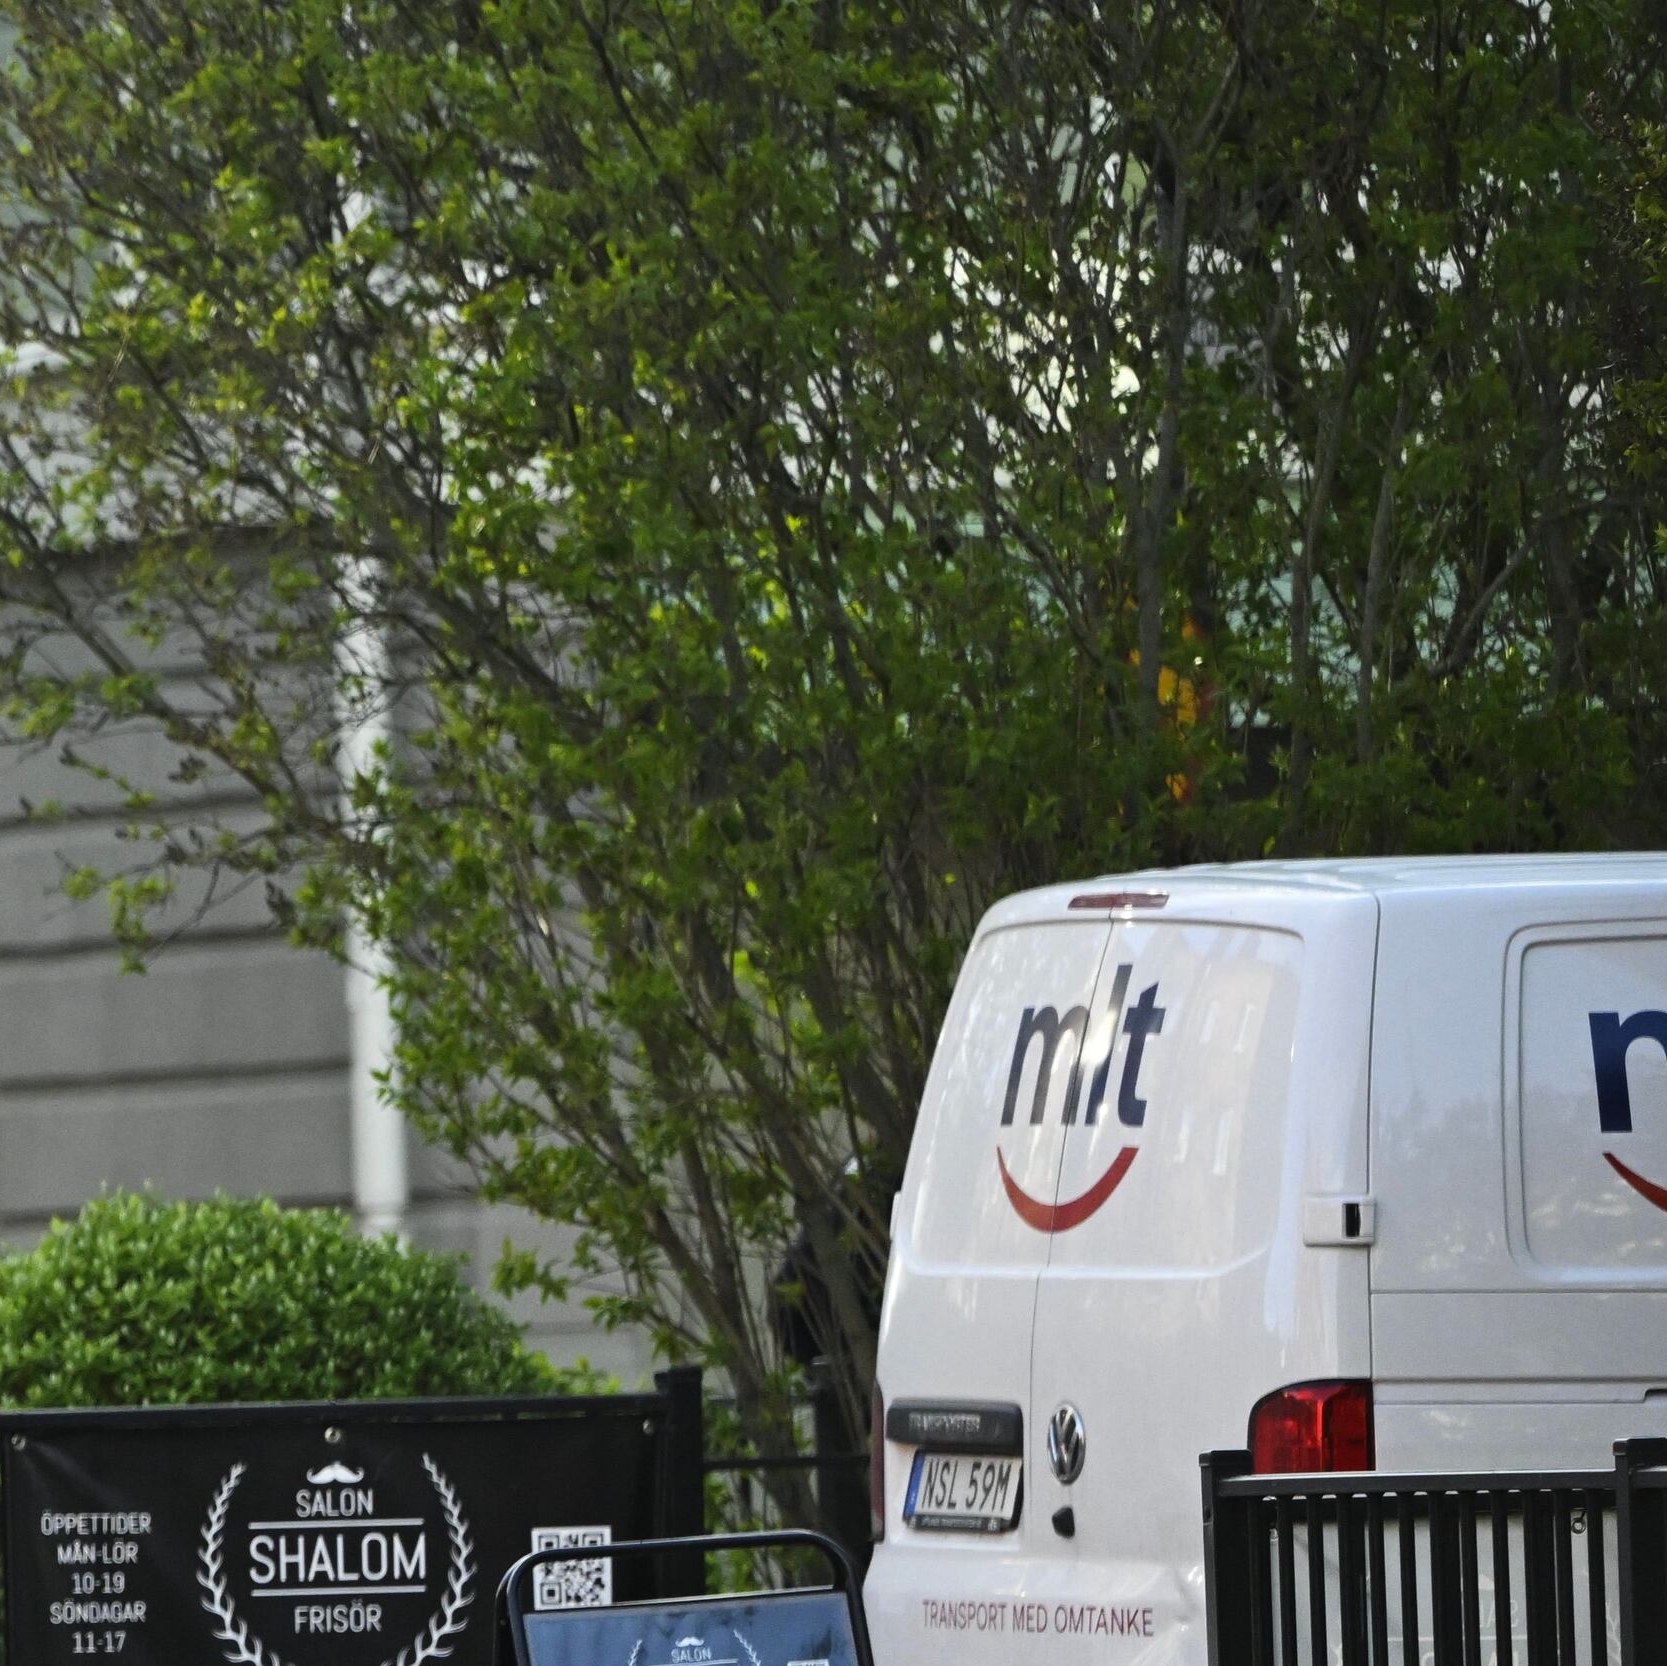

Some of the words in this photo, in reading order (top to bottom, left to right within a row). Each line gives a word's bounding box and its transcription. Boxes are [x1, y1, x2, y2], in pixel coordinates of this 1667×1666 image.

[1000, 963, 1166, 1128] mlt
[921, 1458, 959, 1510] NSL
[965, 1461, 1013, 1512] 59M
[295, 1488, 374, 1518] SALON
[40, 1509, 152, 1536] ÖPPETTIDER
[57, 1538, 139, 1564] MÅN-LÖR
[249, 1531, 426, 1584] SHALOM
[71, 1571, 126, 1595] 10-19
[49, 1598, 147, 1625] SÖNDAGAR
[294, 1599, 383, 1634] FRISÖR
[922, 1600, 1007, 1632] TRANSPORT
[1012, 1604, 1048, 1633] MED
[1054, 1604, 1155, 1637] OMTANKE
[72, 1630, 127, 1654] 11-17
[670, 1646, 712, 1664] SALON
